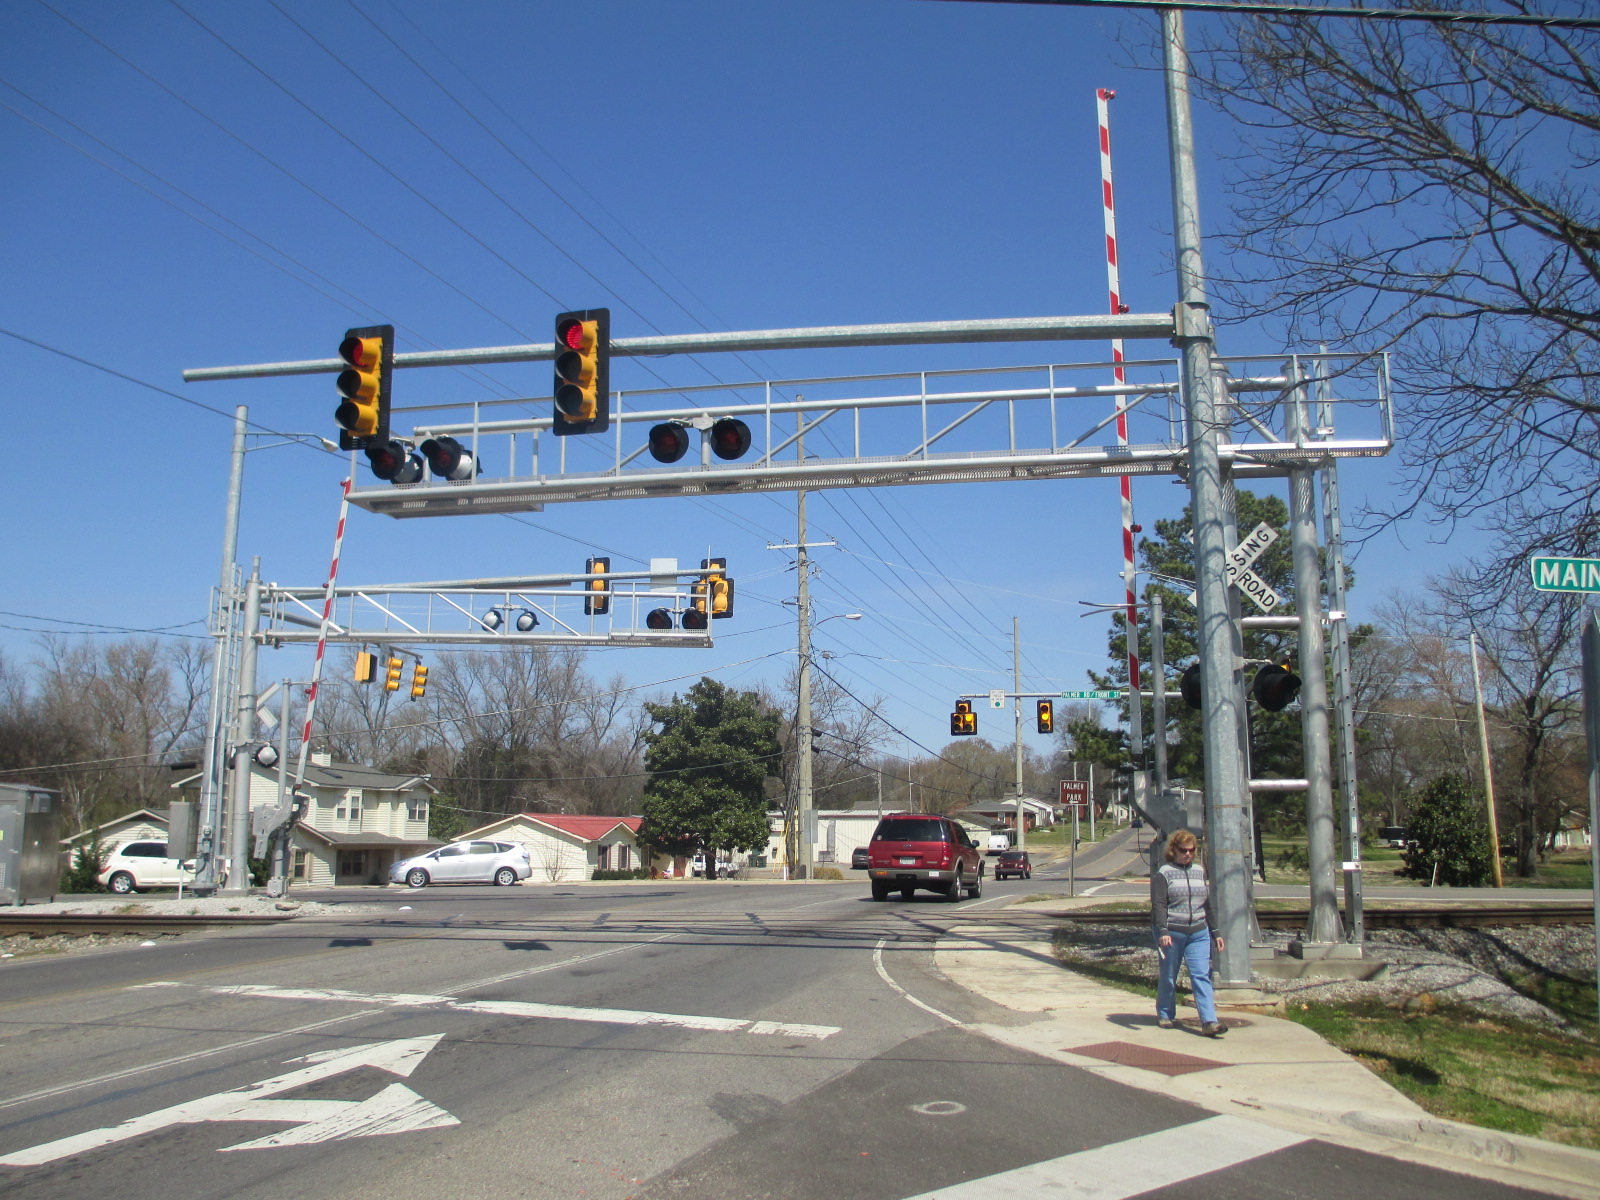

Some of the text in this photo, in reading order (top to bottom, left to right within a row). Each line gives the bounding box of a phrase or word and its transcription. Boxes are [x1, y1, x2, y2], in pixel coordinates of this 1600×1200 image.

[1540, 561, 1600, 588] MAIN
[1238, 571, 1275, 607] ROAD
[1063, 782, 1084, 790] PALMER
[1066, 793, 1082, 801] PARK
